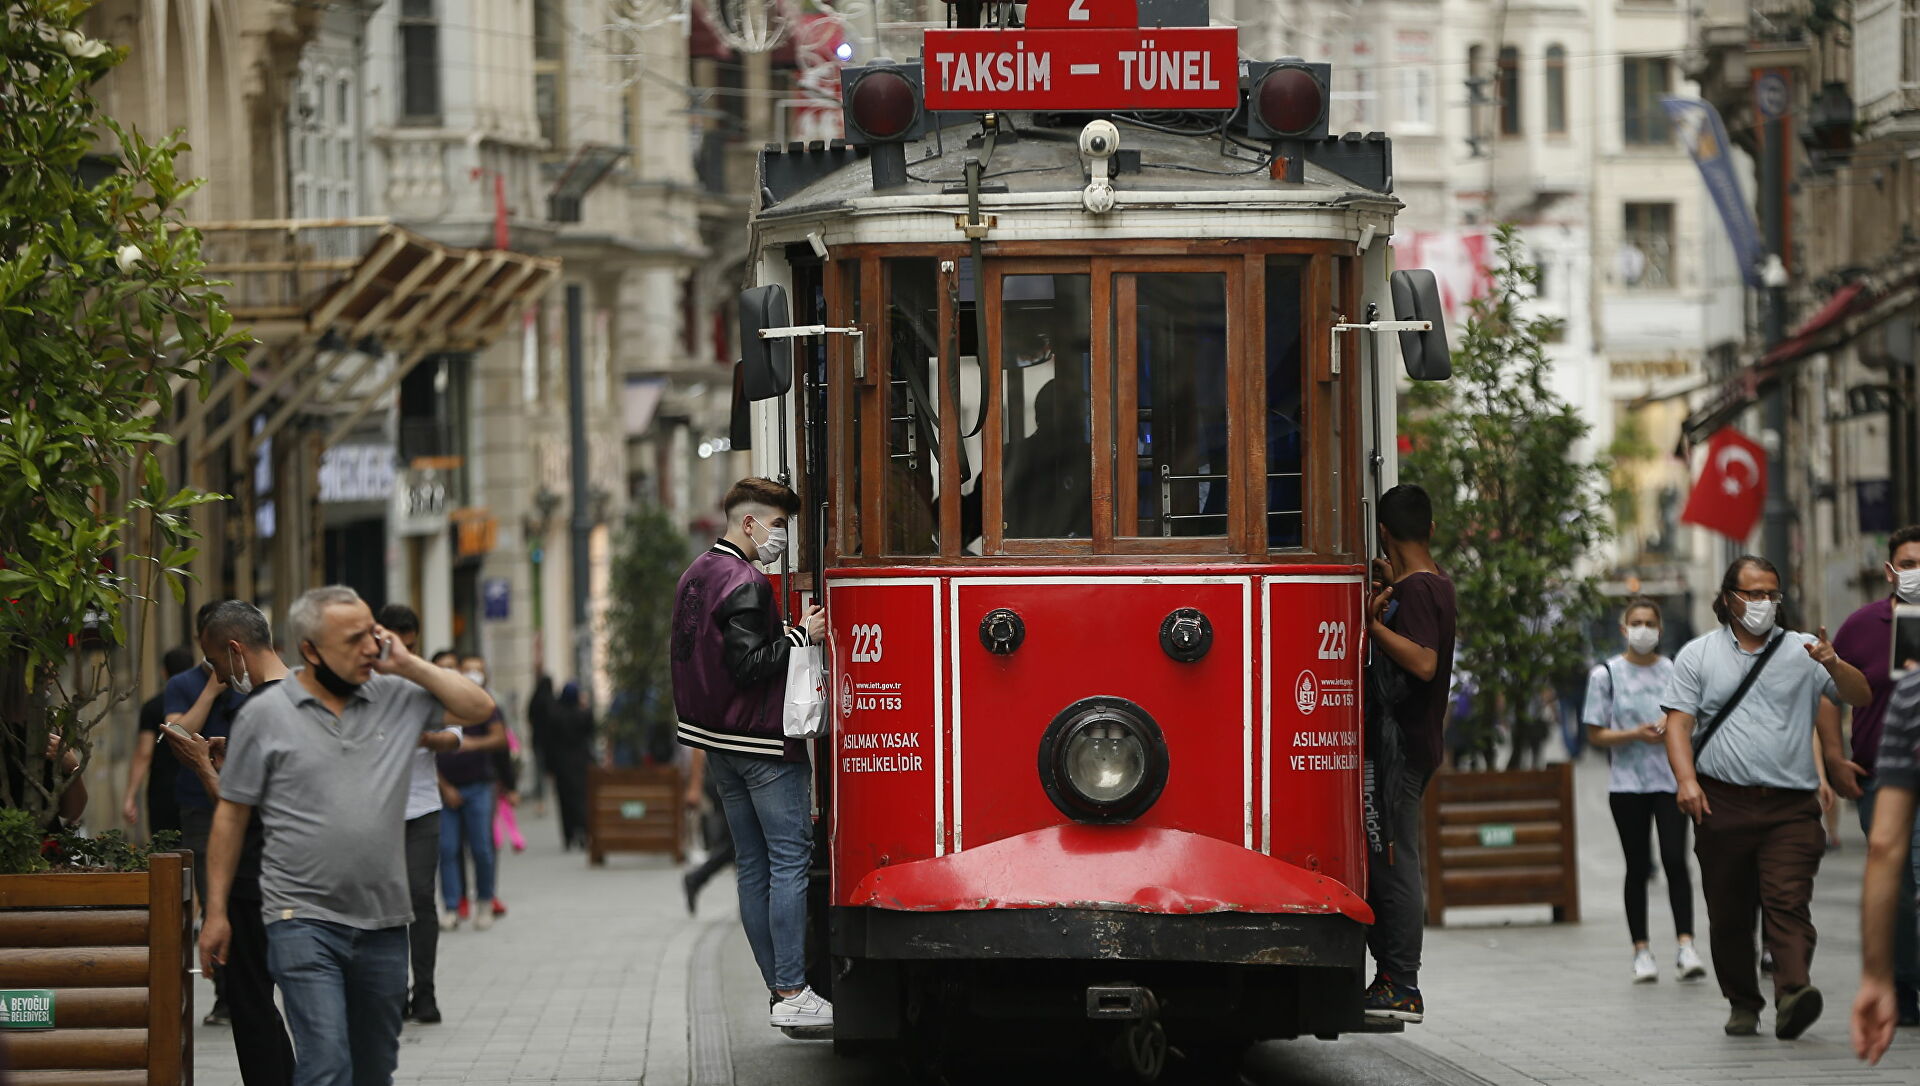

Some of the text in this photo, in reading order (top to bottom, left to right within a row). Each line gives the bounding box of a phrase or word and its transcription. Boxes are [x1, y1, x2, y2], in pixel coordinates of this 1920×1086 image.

[936, 40, 1050, 91] TAKSİM
[1118, 39, 1220, 91] TÜNEL
[851, 624, 882, 663] 223
[1318, 621, 1346, 660] 223
[856, 682, 902, 690] www.iett.gov.tr
[856, 698, 876, 710] ALO
[879, 698, 902, 710] 153
[1321, 694, 1341, 707] ALO
[843, 732, 920, 750] ASILMAK YASAK
[1293, 732, 1339, 747] ASILMAK
[842, 753, 923, 773] VE TEHLİKELİDİR
[1290, 755, 1306, 771] VE
[1363, 792, 1383, 853] adidas
[11, 995, 50, 1011] BEYOĞLU
[11, 1010, 50, 1022] BELEDİYESİ
